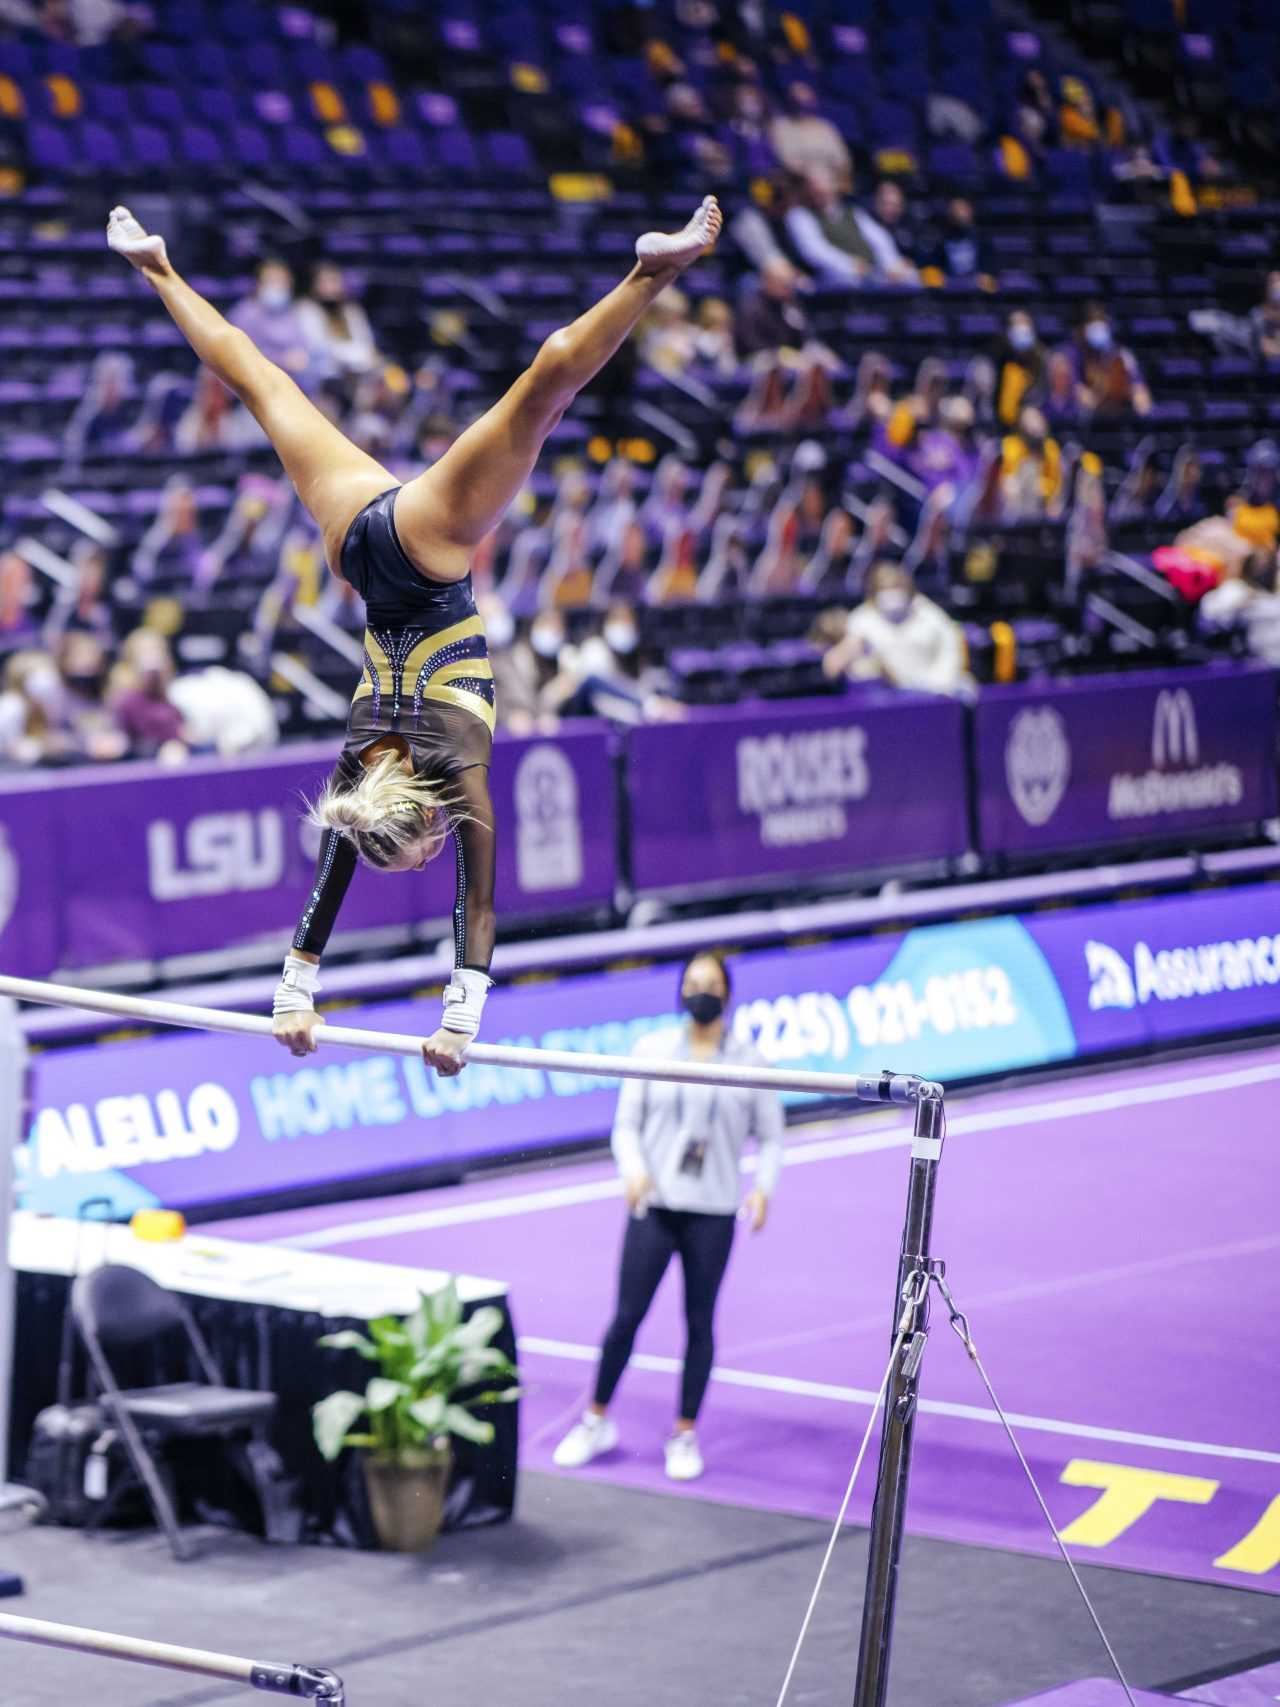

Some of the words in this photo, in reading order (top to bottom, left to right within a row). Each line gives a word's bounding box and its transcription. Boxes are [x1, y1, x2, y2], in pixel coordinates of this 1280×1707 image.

[147, 808, 283, 902] LSU
[1134, 934, 1280, 1004] Assuranc
[251, 1056, 406, 1141] HOME
